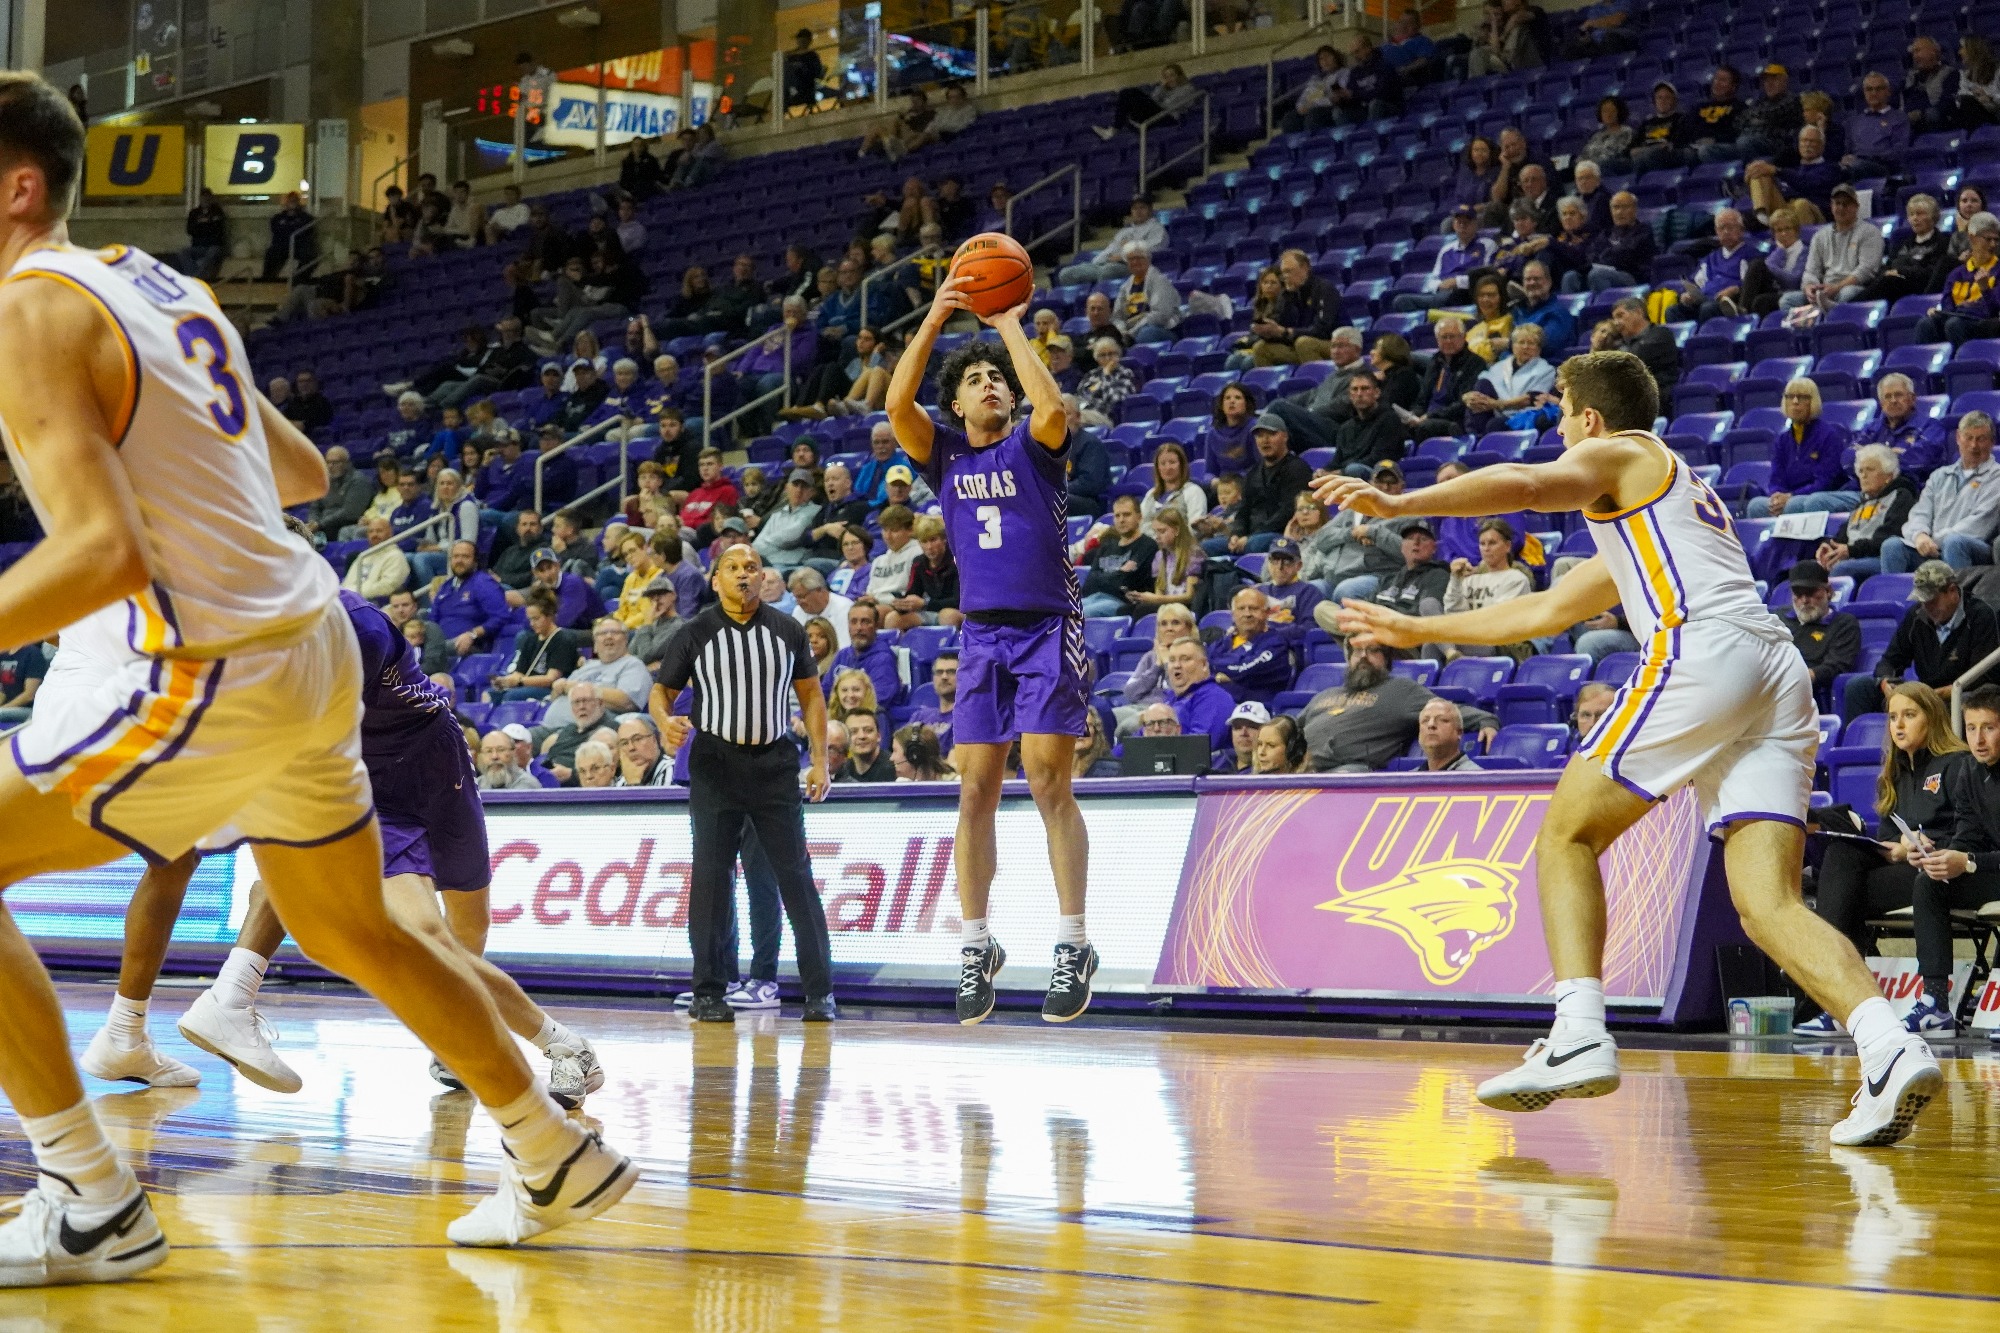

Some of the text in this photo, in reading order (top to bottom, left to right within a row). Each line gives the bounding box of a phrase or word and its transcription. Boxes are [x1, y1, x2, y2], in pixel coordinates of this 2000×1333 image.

[108, 134, 161, 185] U
[228, 133, 281, 185] B
[175, 314, 248, 442] 3
[954, 470, 1017, 499] LORAS
[976, 505, 1003, 549] 3
[1336, 794, 1554, 896] UNI
[490, 837, 1001, 932] Ceda all
